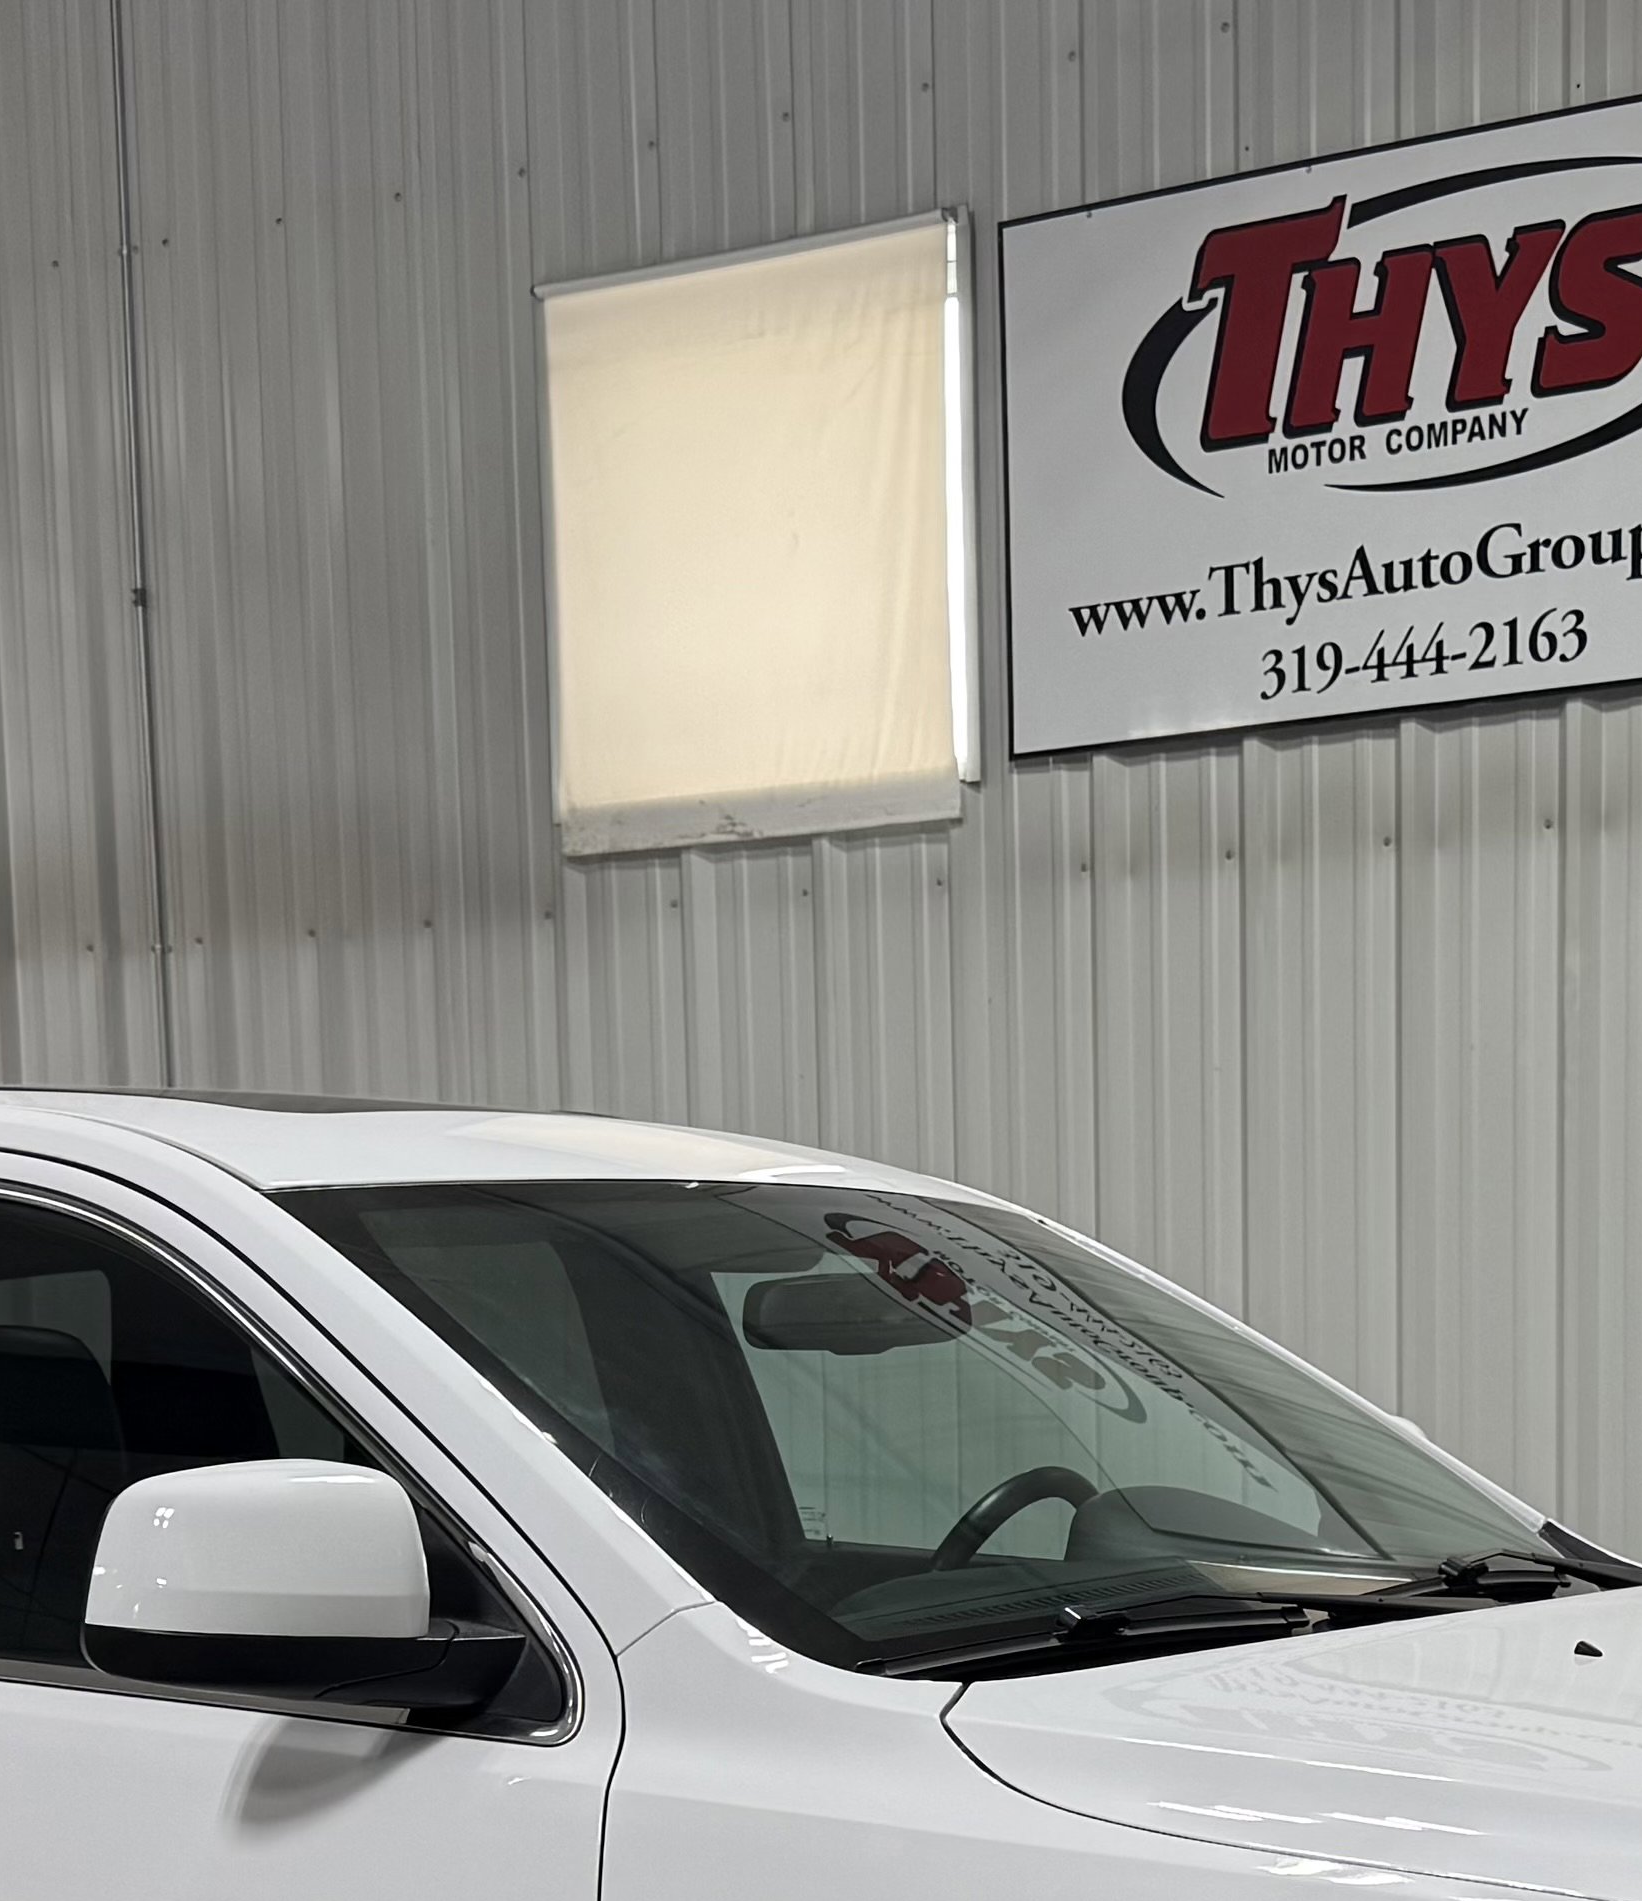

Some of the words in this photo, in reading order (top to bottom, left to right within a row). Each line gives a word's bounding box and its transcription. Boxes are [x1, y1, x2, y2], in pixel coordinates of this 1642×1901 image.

[1267, 434, 1367, 474] MOTOR
[1385, 408, 1529, 455] COMPANY
[1260, 608, 1588, 700] 319-444-2163
